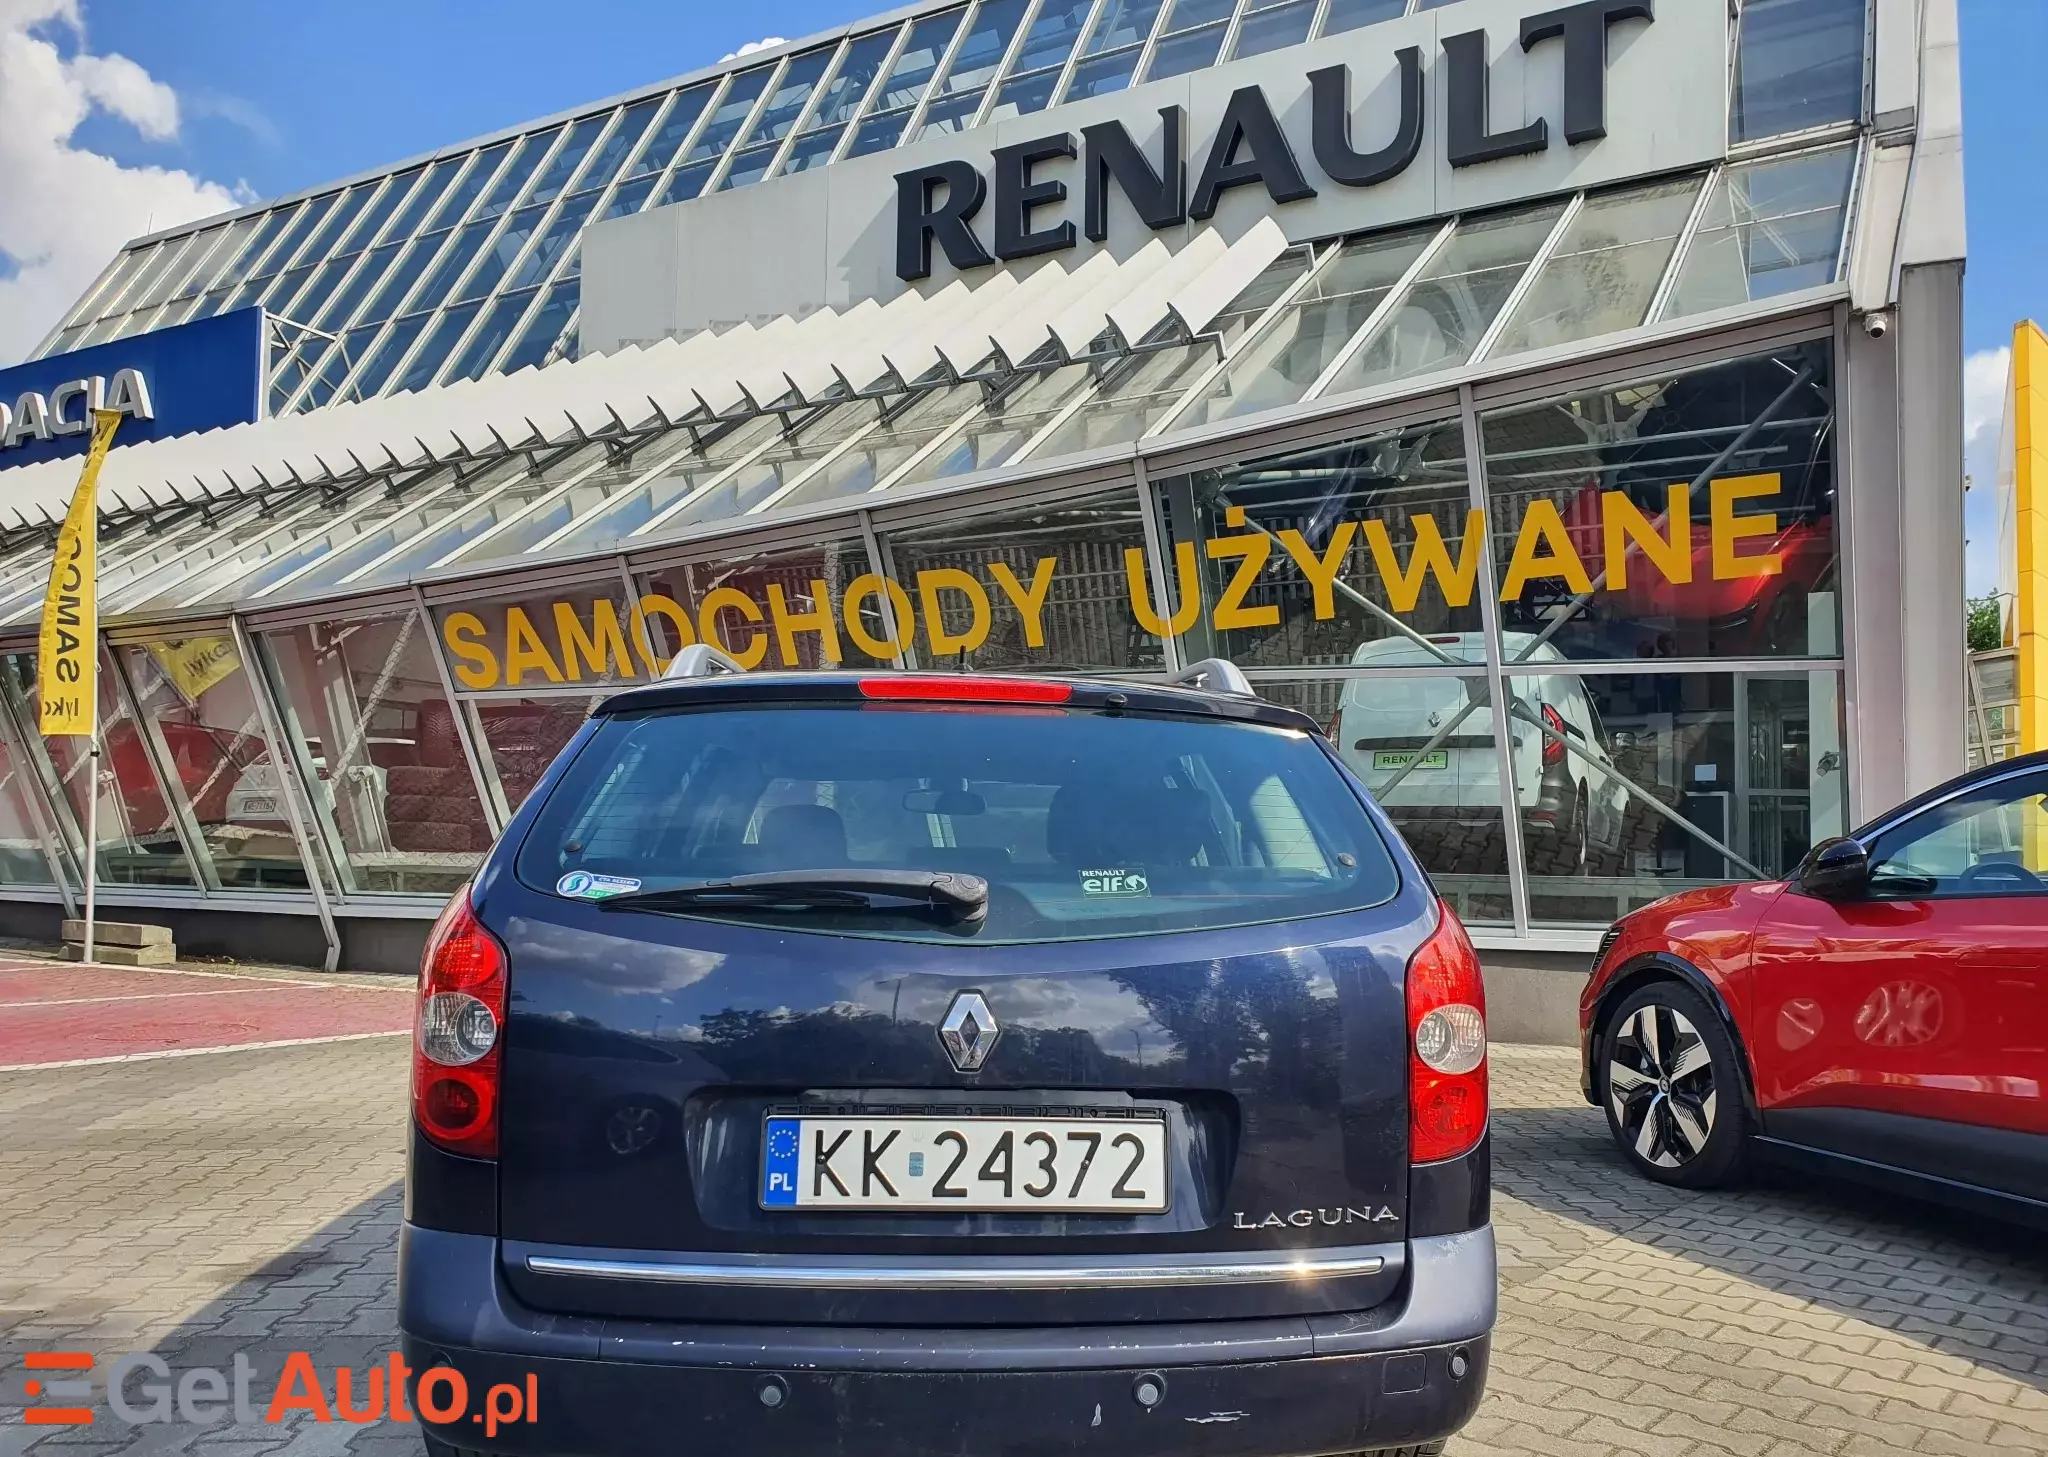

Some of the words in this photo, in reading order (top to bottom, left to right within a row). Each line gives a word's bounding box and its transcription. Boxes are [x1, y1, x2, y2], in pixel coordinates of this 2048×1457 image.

[893, 0, 1655, 281] RENAULT
[443, 556, 1058, 689] SAMOCHODY
[1124, 472, 1782, 637] UŻYWANE
[1082, 869, 1127, 877] RENAULT
[1083, 876, 1123, 892] elf
[813, 1129, 901, 1197] KK
[932, 1130, 1146, 1199] 24372
[769, 1173, 793, 1192] PL
[1233, 1205, 1400, 1229] LAGUNA
